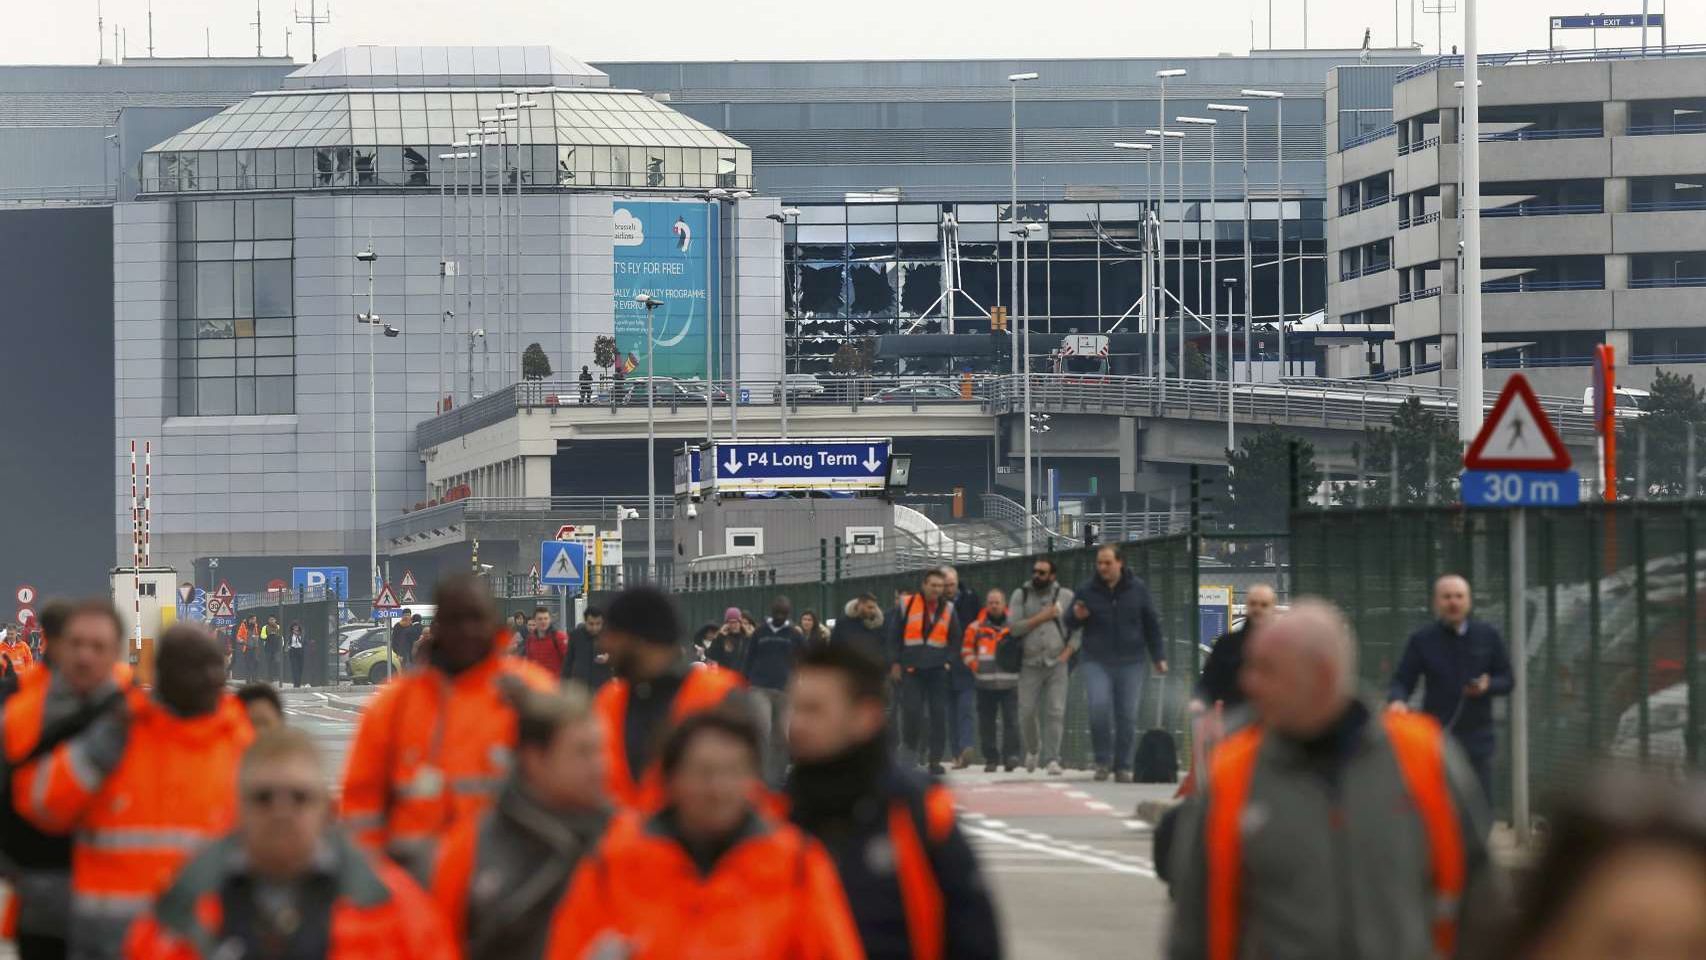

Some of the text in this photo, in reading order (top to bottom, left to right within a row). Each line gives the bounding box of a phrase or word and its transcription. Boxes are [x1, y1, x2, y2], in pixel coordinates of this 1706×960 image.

[628, 262, 641, 274] FLY
[643, 262, 660, 274] FOR
[662, 262, 684, 275] FREE!
[665, 289, 705, 299] PROGRAMME
[747, 452, 857, 469] P4 Long Term
[1484, 474, 1559, 502] 30 m
[307, 571, 326, 592] P
[210, 602, 219, 610] 30
[378, 610, 389, 618] 30
